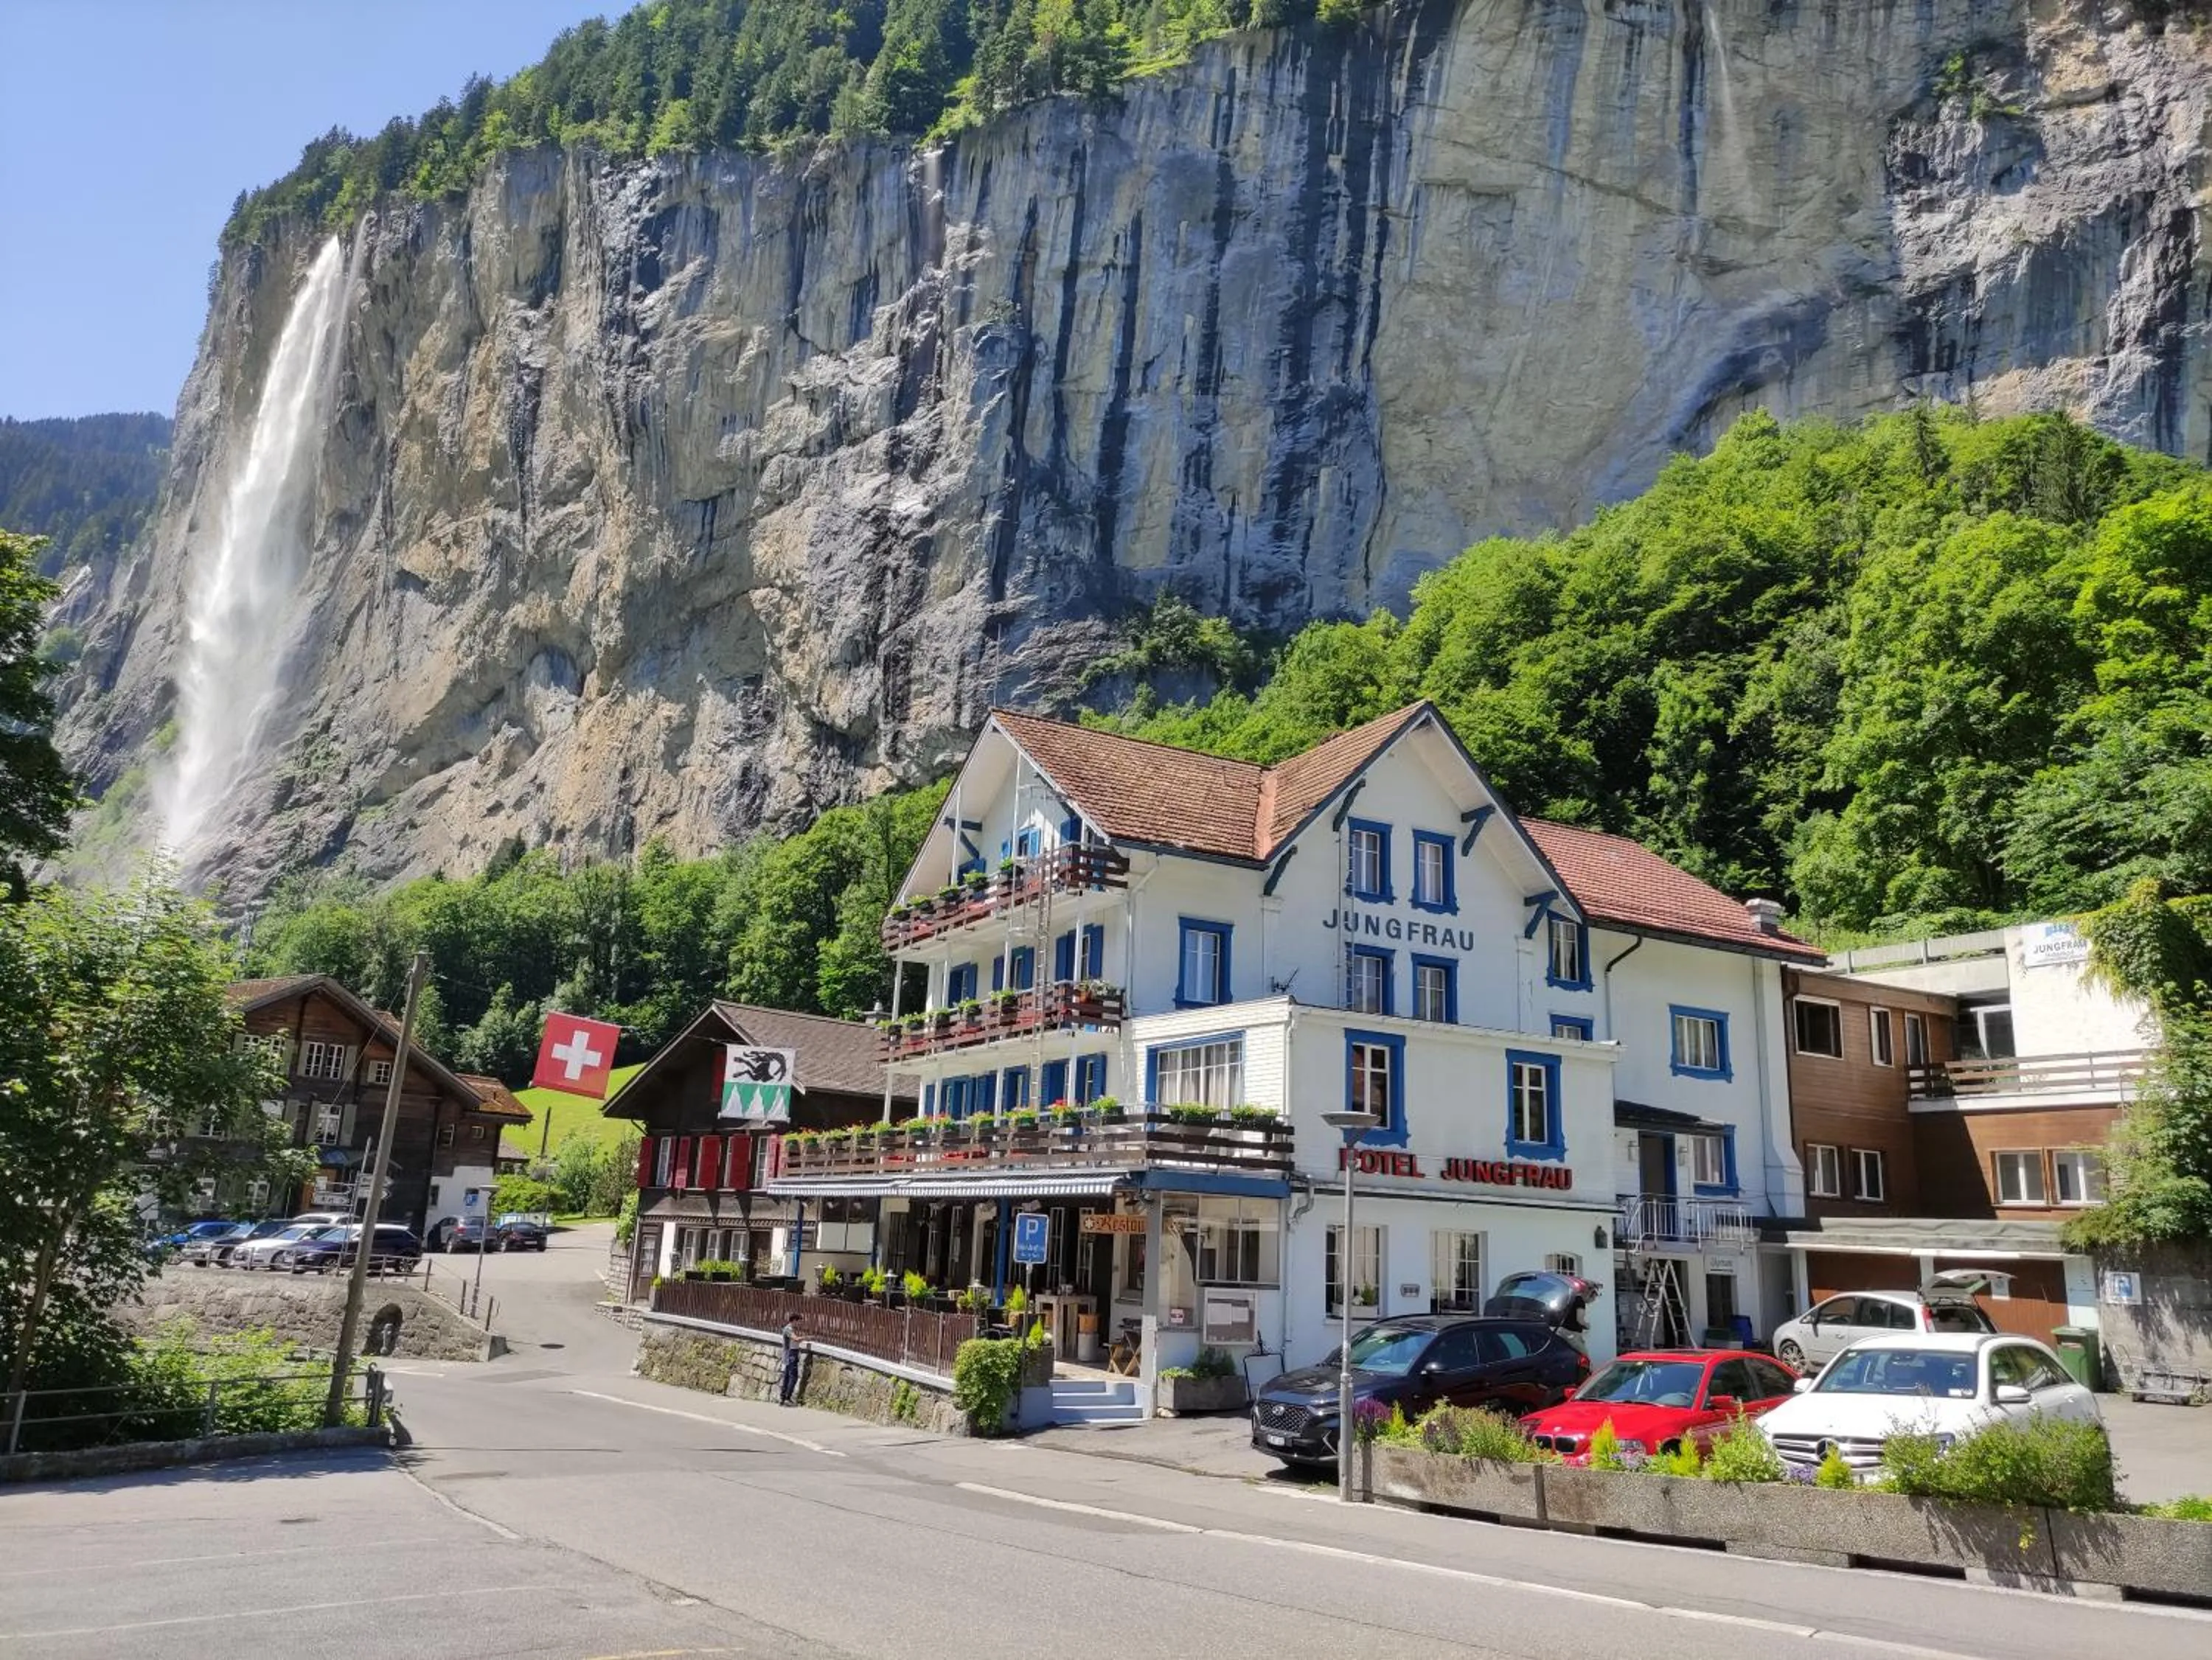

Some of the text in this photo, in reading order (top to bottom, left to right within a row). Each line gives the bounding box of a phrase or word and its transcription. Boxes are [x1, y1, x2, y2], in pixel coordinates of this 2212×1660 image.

[1322, 908, 1474, 952] JUNGFRAU
[1440, 1157, 1573, 1190] JUNGFRAU
[1026, 1218, 1039, 1241] P
